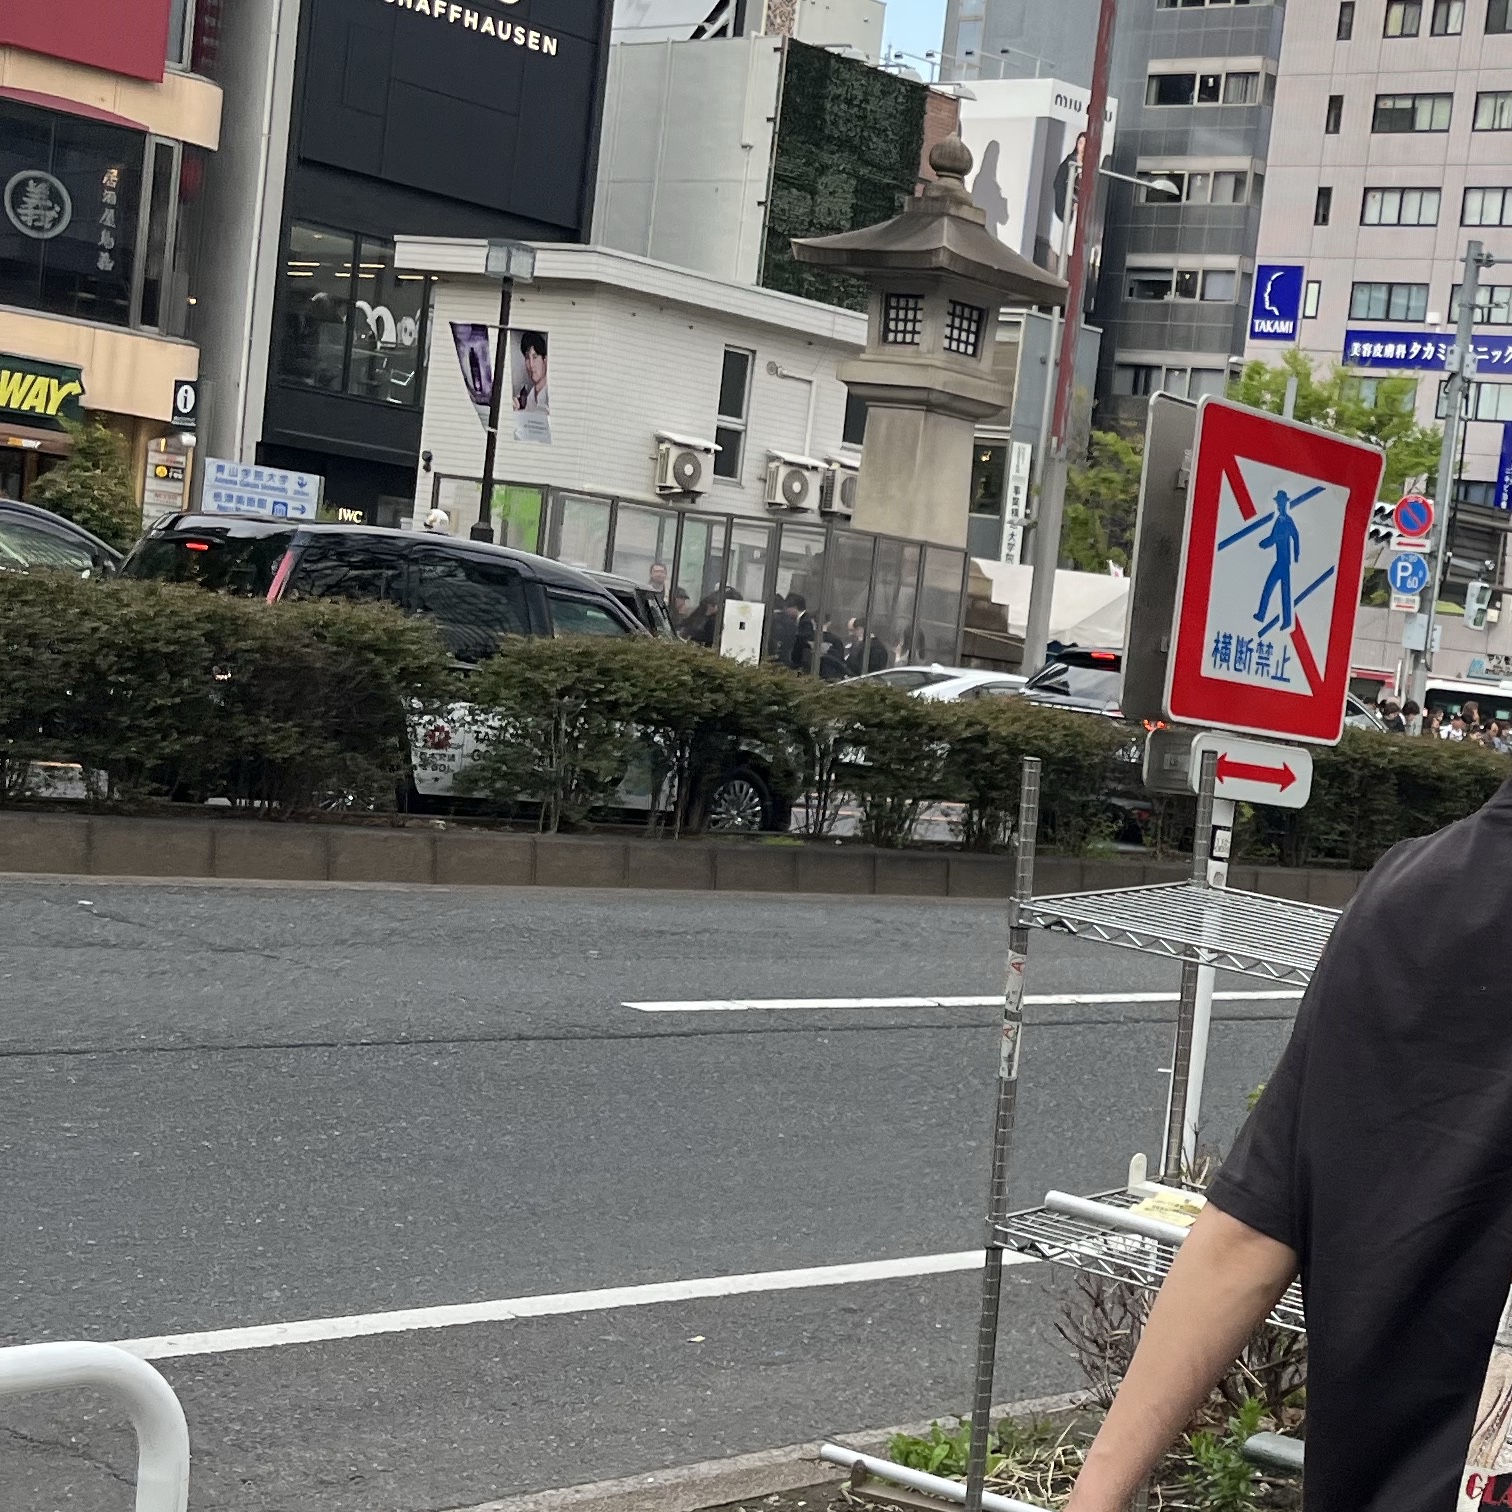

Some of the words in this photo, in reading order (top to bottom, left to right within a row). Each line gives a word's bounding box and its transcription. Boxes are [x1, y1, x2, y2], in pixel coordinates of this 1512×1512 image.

[382, 0, 558, 56] AFFHAUSEN
[1253, 318, 1294, 334] TAKAMI
[338, 507, 363, 524] IWC
[1397, 561, 1413, 588] P
[1212, 630, 1292, 683] 横断禁止
